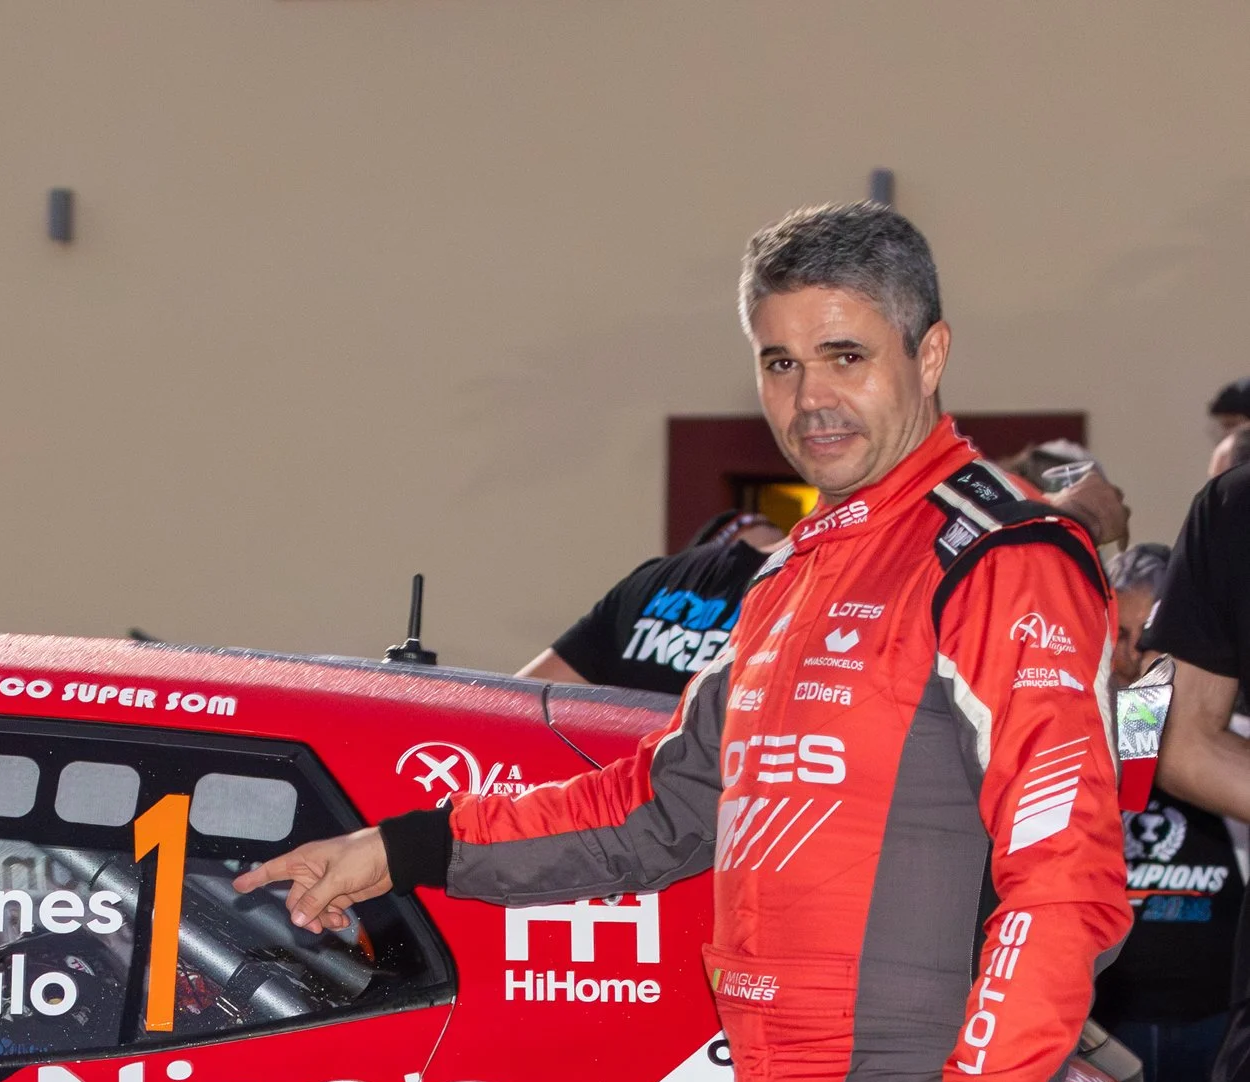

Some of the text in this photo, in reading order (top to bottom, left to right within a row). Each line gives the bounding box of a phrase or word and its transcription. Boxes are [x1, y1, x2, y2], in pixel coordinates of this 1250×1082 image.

[828, 603, 886, 619] LOTES
[61, 682, 157, 709] SUPER
[165, 691, 238, 717] SOM
[806, 681, 852, 706] Diera
[133, 793, 191, 1032] 1
[504, 969, 662, 1004] HiHome
[723, 983, 776, 1001] NUNES
[725, 970, 781, 989] MIGUEL
[956, 910, 1033, 1076] LOTES
